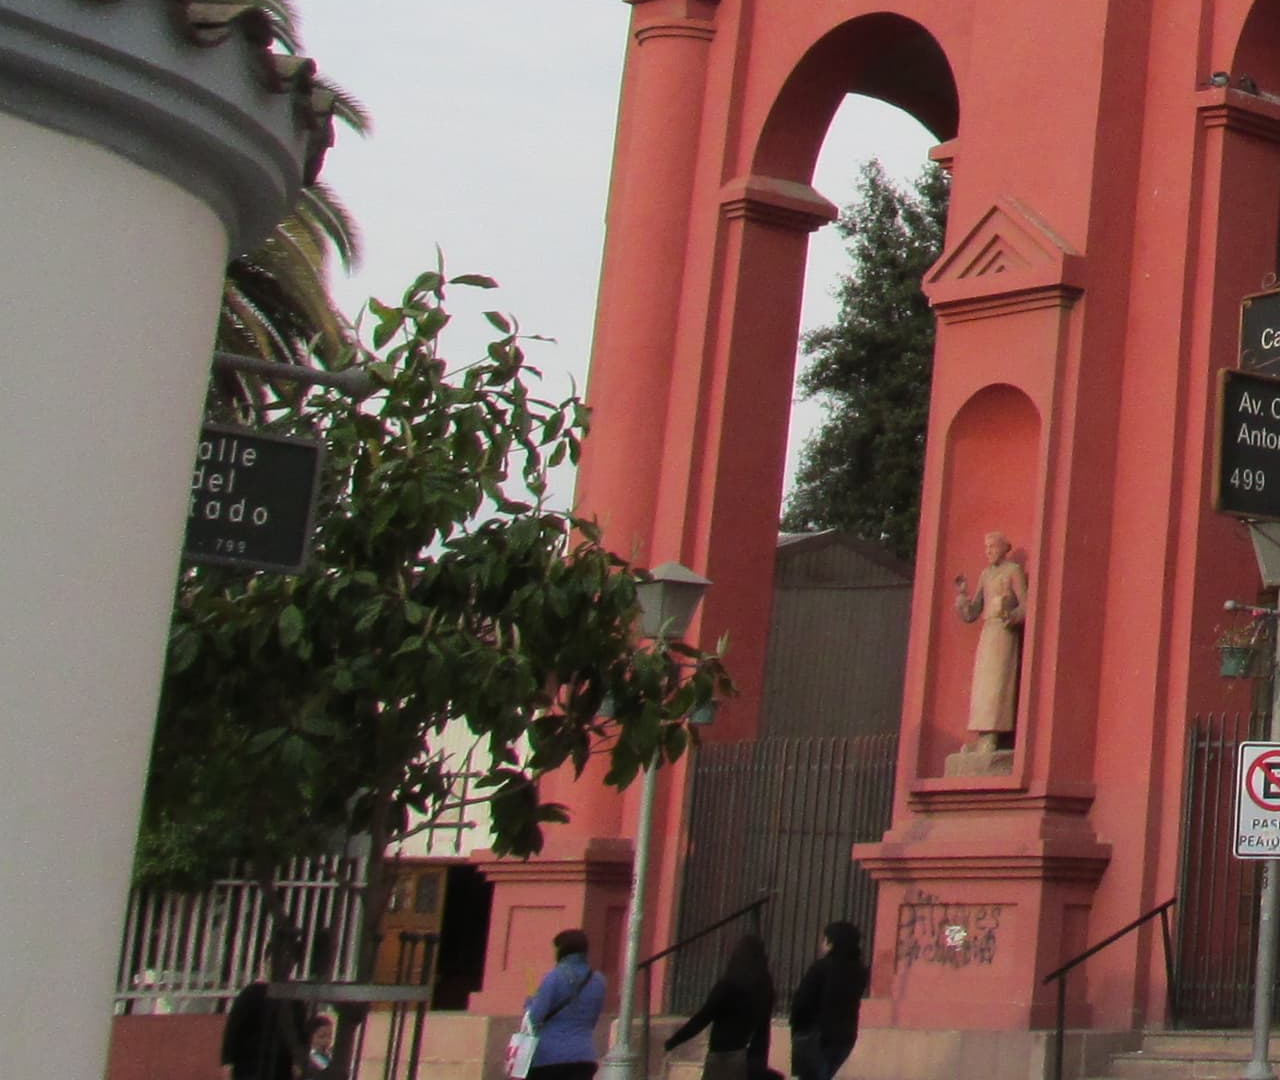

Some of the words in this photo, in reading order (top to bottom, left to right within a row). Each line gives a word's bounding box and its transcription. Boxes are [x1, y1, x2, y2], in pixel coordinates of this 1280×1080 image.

[1238, 391, 1264, 417] Av.
[199, 437, 257, 467] alle
[1230, 467, 1266, 492] 499
[191, 495, 268, 526] tado
